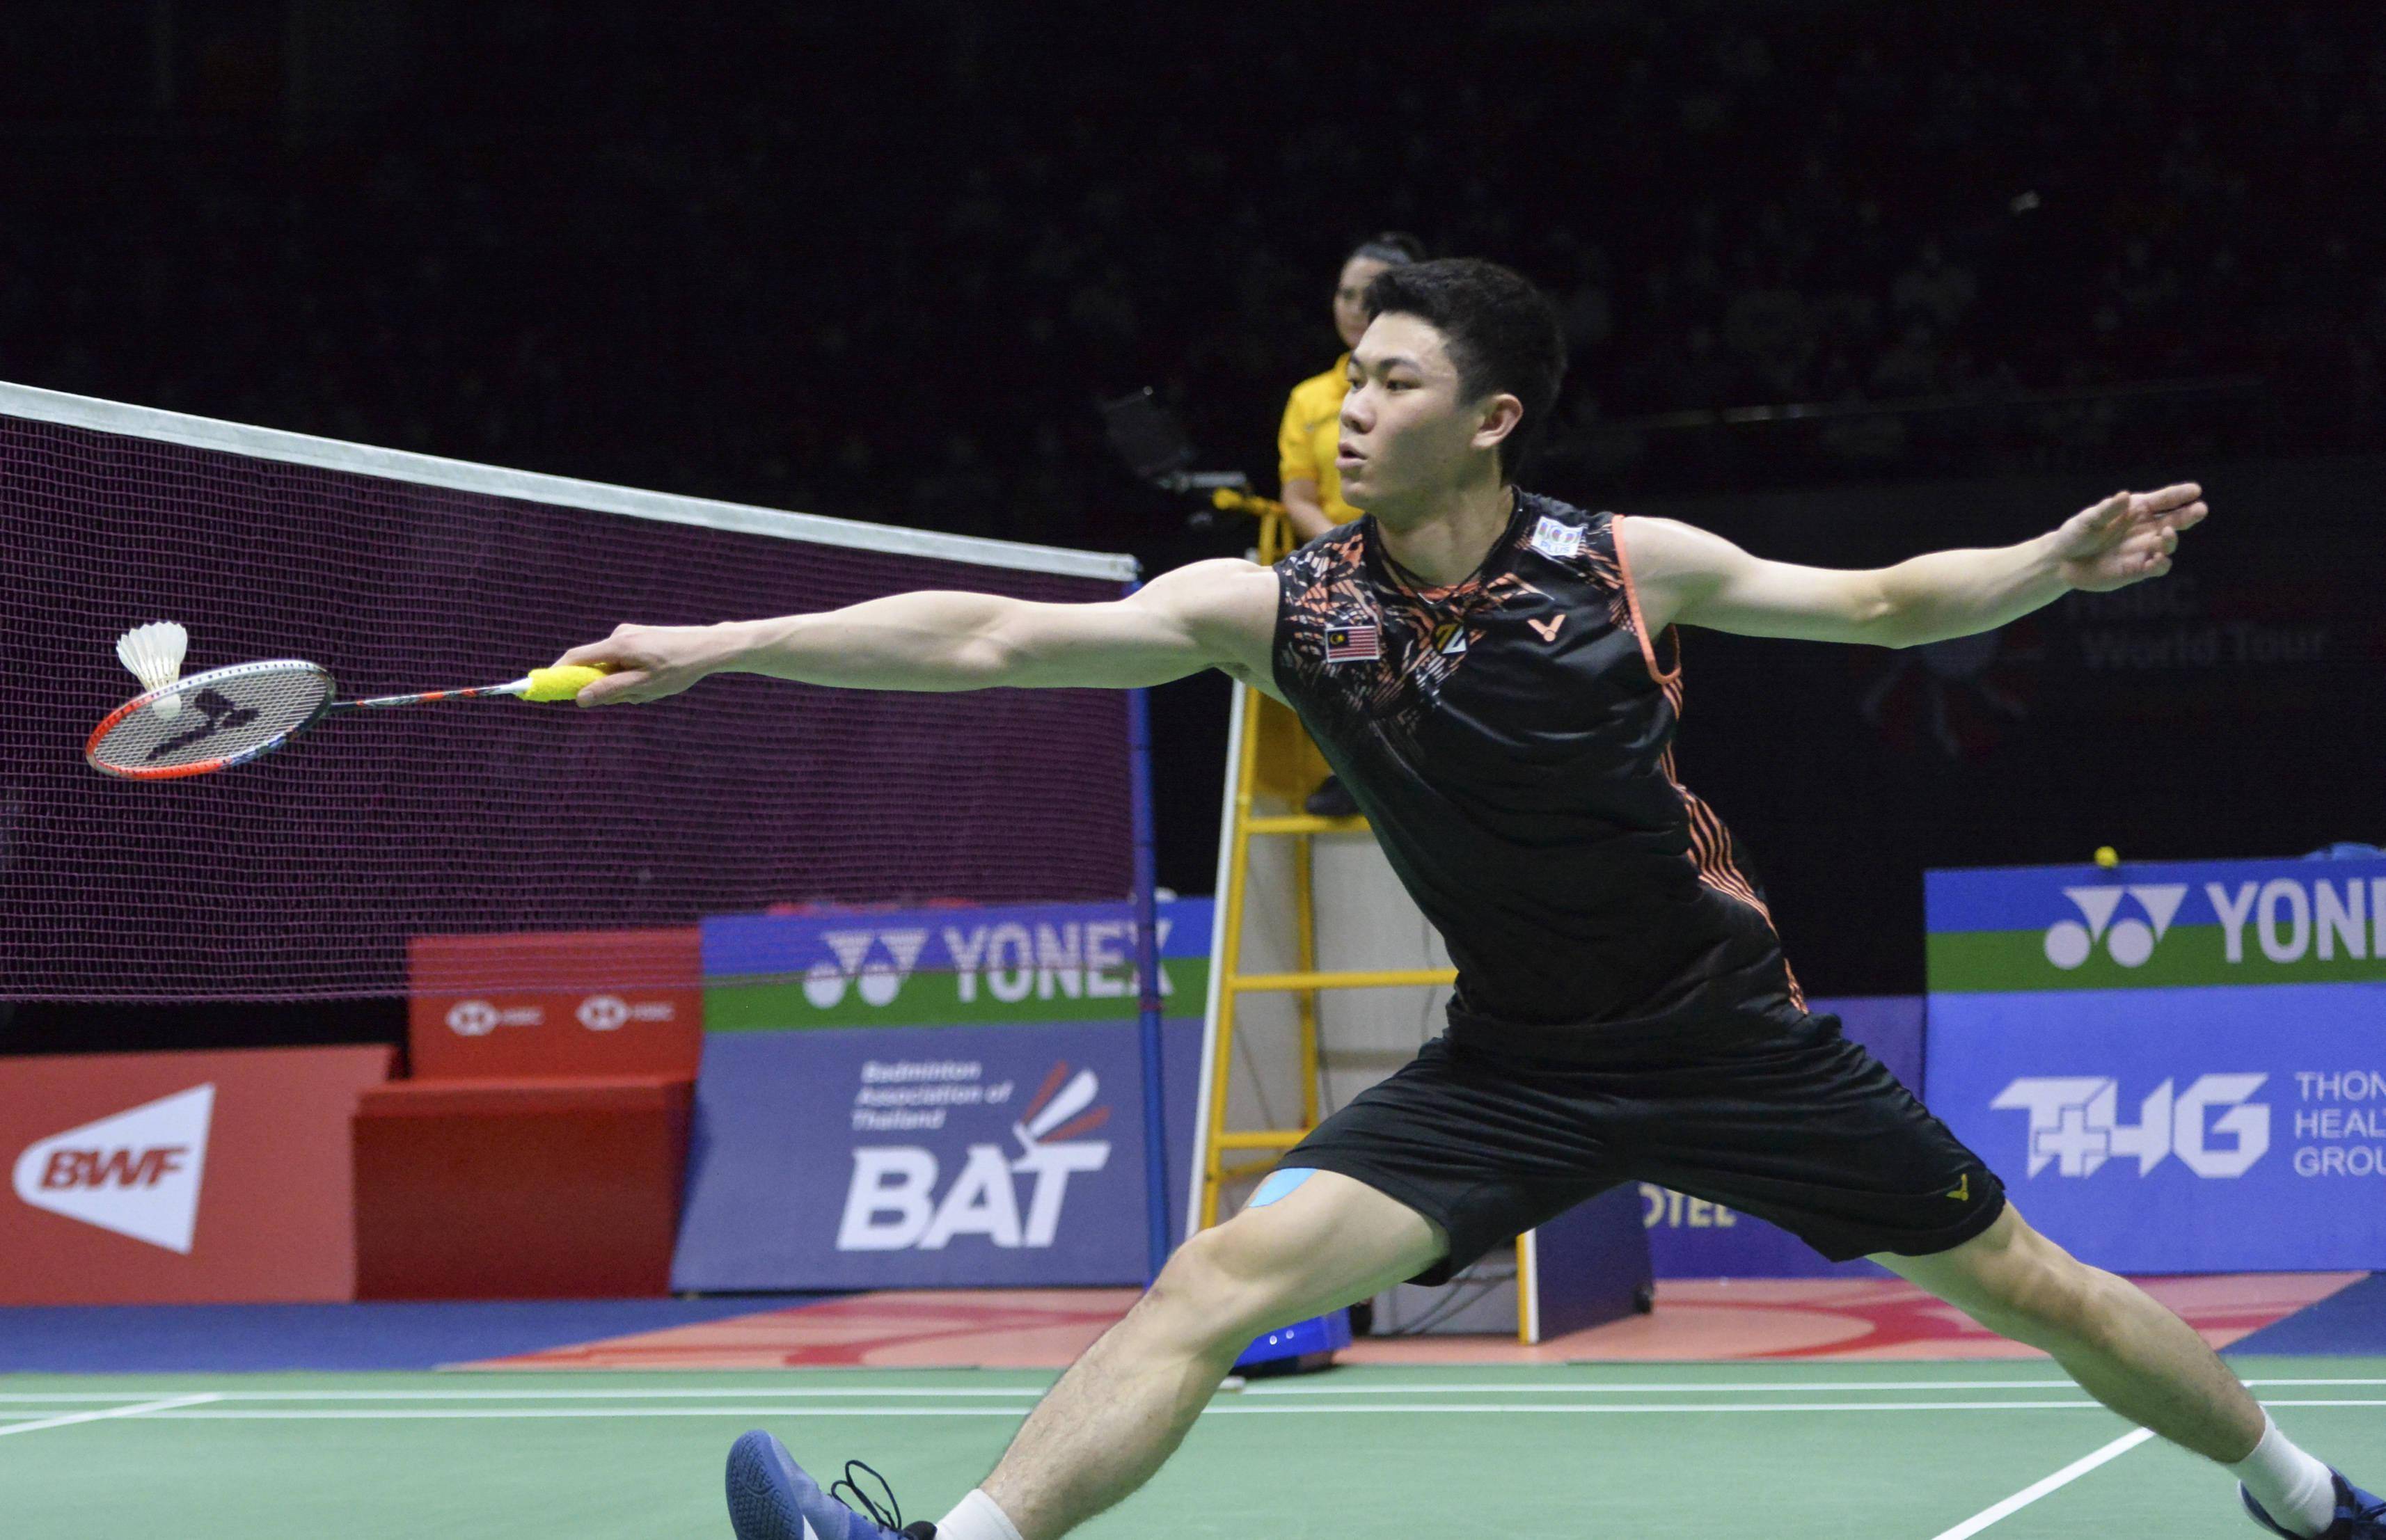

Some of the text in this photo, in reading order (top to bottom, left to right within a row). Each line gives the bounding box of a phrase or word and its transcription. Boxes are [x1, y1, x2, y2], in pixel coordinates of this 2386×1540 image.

[2081, 621, 2328, 669] World Tour
[861, 1061, 982, 1083] Badminton
[853, 1079, 1015, 1107] Association of
[851, 1107, 947, 1131] Thailand
[2296, 1109, 2386, 1138] HEAL
[38, 1144, 195, 1191] BWF
[837, 1140, 1112, 1252] BAT
